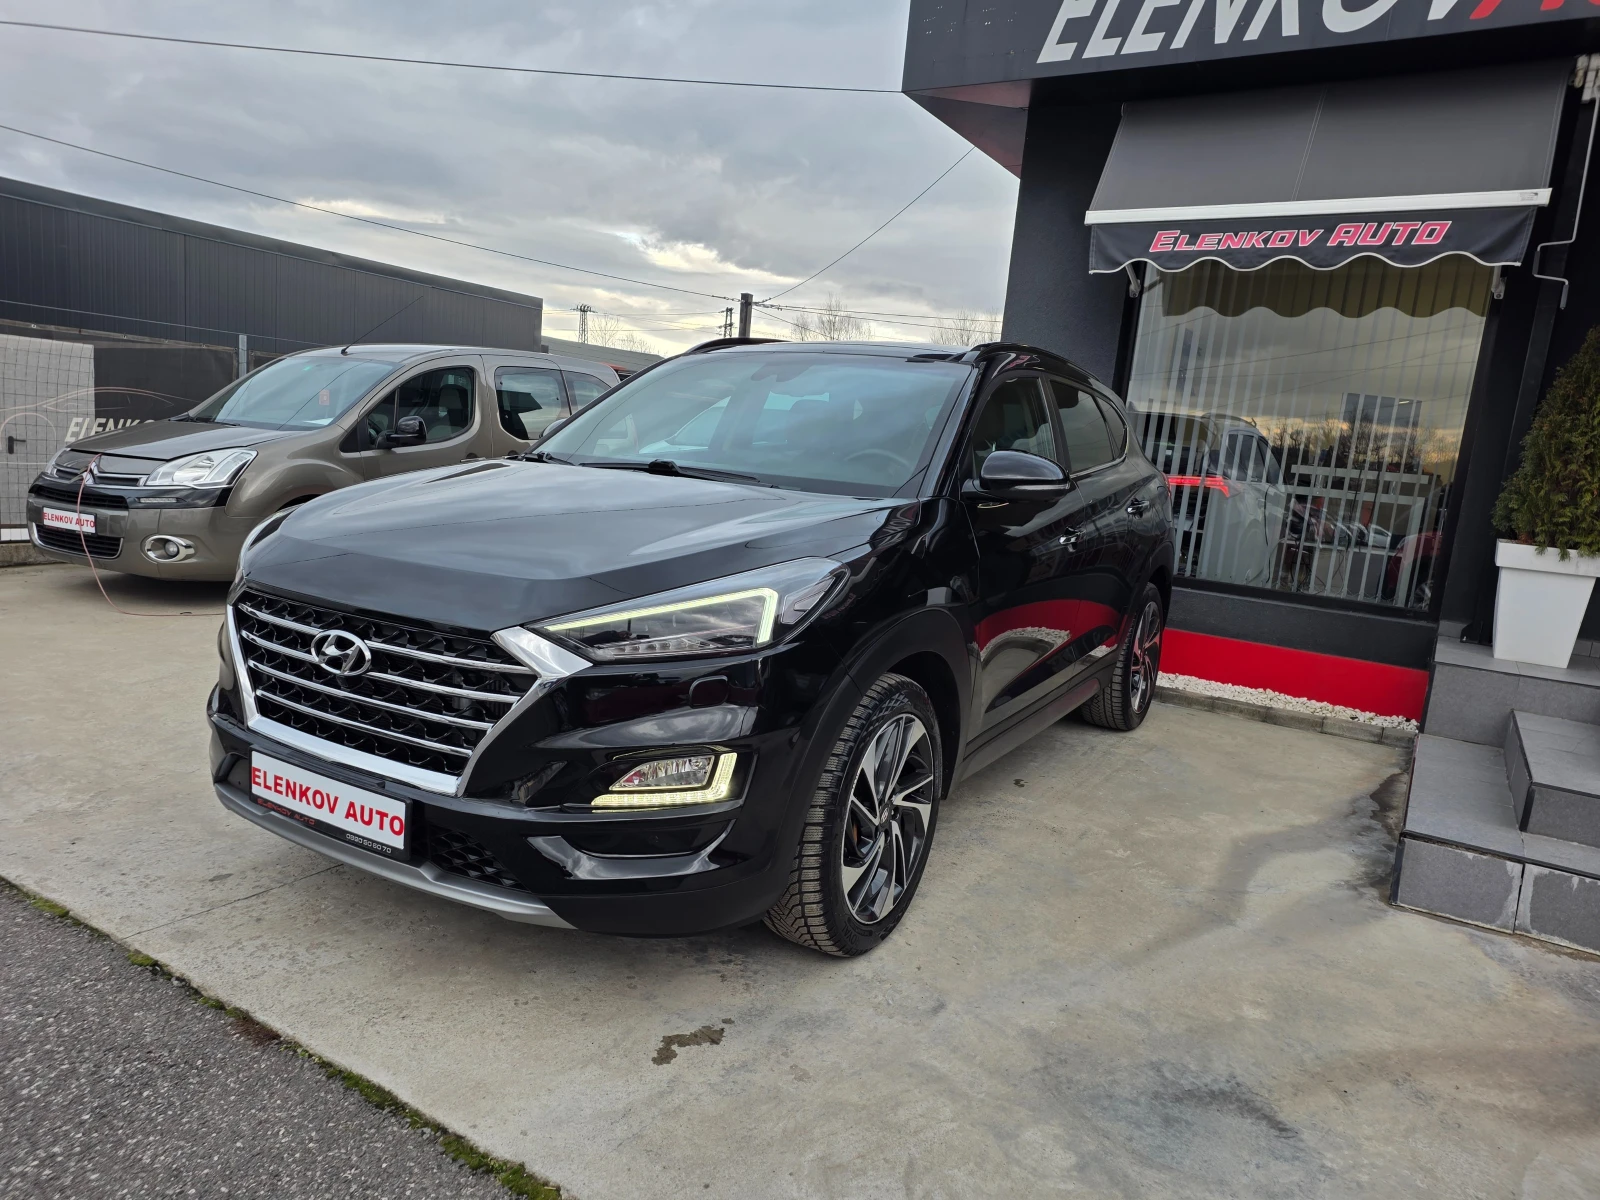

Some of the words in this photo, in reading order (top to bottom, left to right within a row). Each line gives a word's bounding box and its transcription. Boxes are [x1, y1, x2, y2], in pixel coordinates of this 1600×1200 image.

[1036, 0, 1459, 64] ELEN
[1149, 229, 1324, 252] ELENKOV
[1327, 221, 1452, 246] AUTO
[43, 512, 74, 525] ELENKOV
[75, 518, 96, 528] AUTO
[252, 766, 339, 815] ELENKOV
[344, 801, 405, 836] AUTO
[257, 798, 291, 816] ELENKOV
[294, 813, 316, 826] AUTO
[382, 845, 392, 853] 70
